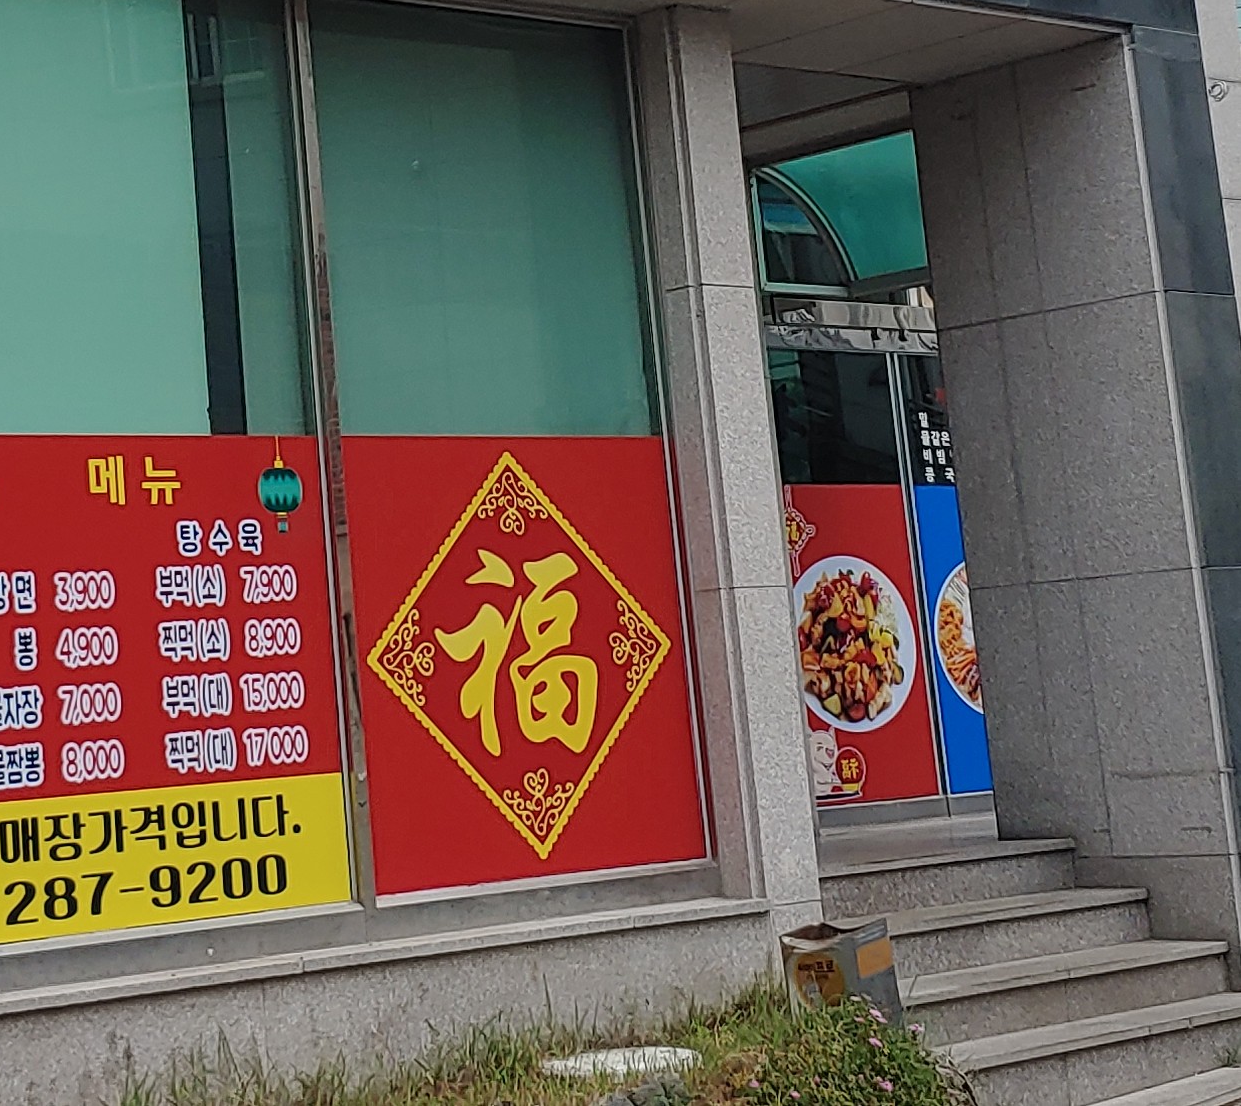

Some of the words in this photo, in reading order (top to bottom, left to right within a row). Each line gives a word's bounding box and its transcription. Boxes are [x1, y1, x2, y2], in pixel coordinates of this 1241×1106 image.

[54, 571, 116, 612] 3,900
[240, 564, 297, 603] 7,900
[55, 626, 118, 669] 4,900
[244, 618, 302, 657] 8,900
[434, 549, 599, 757] 福
[57, 682, 122, 726] 7,000
[239, 671, 305, 712] 15,000
[61, 738, 125, 783] 8,000
[3, 854, 288, 927] 287-9200
